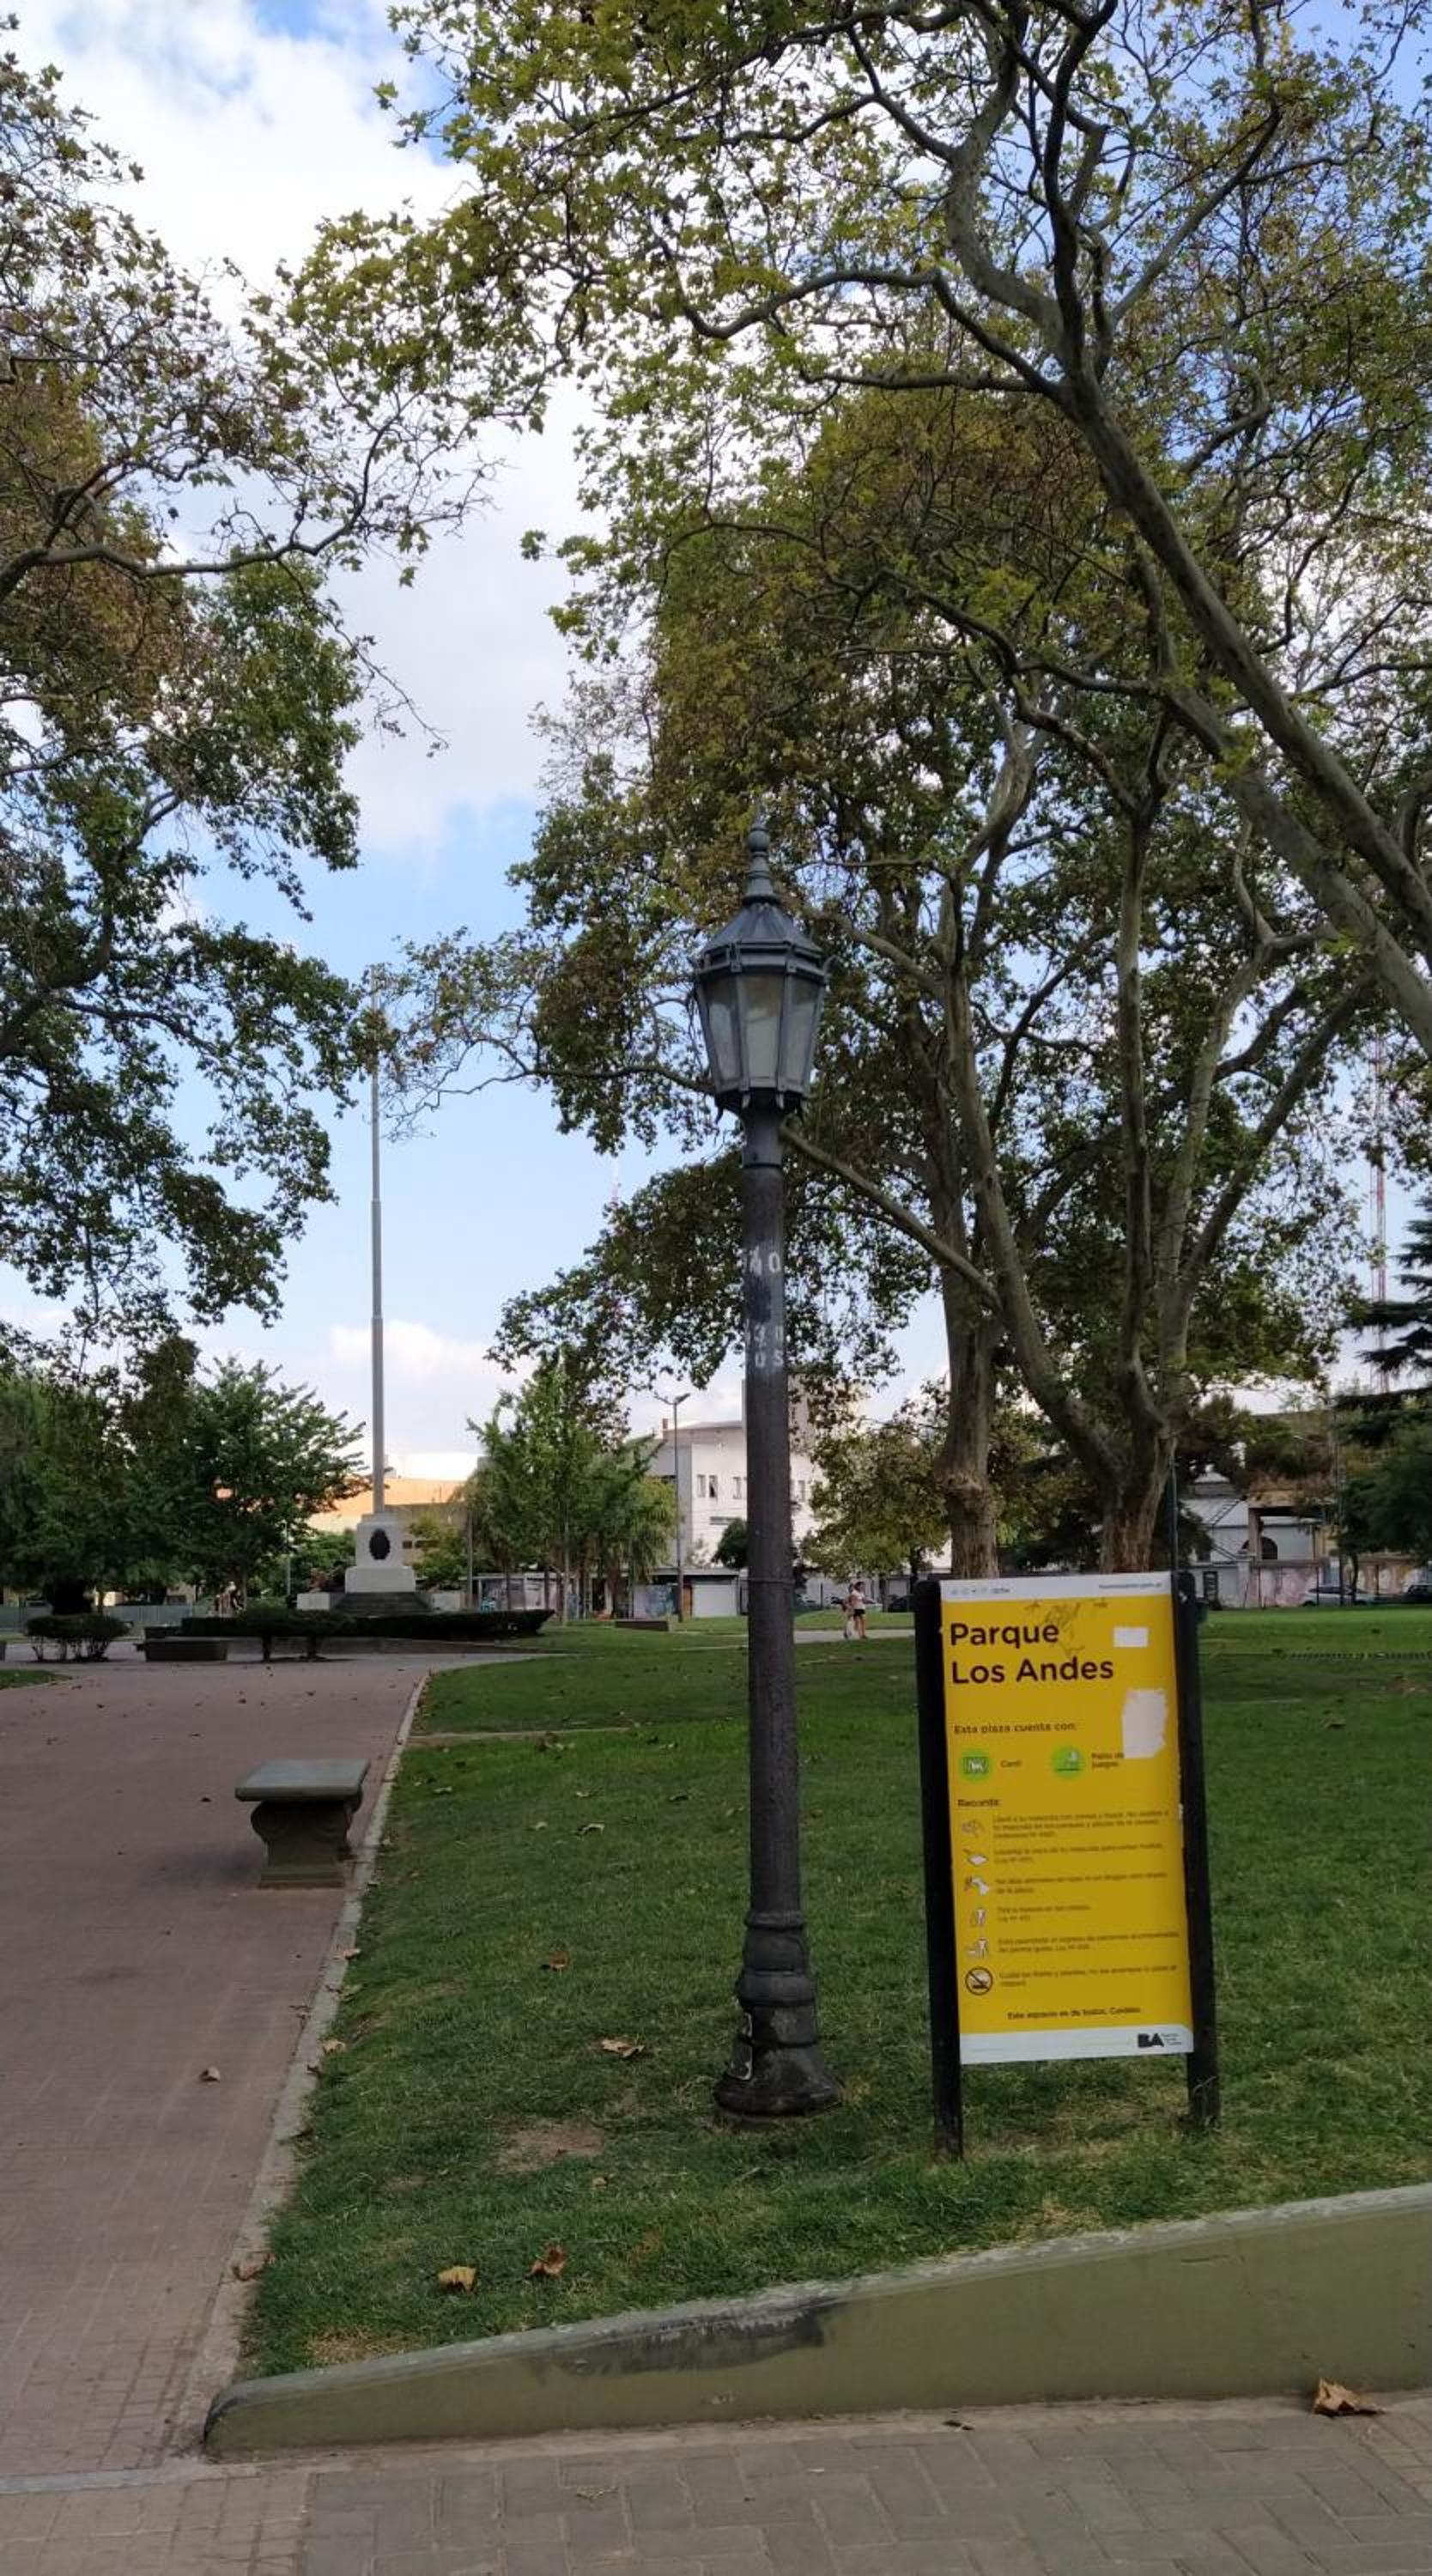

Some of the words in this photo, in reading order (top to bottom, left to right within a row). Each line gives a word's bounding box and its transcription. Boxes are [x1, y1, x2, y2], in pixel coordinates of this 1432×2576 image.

[950, 1622, 1059, 1649] Parque
[951, 1661, 1005, 1684] Los
[1016, 1656, 1113, 1682] Andes
[954, 1724, 978, 1735] Esta
[980, 1723, 1010, 1735] plaza
[1014, 1722, 1051, 1732] cuenta
[1137, 2032, 1164, 2049] BA
